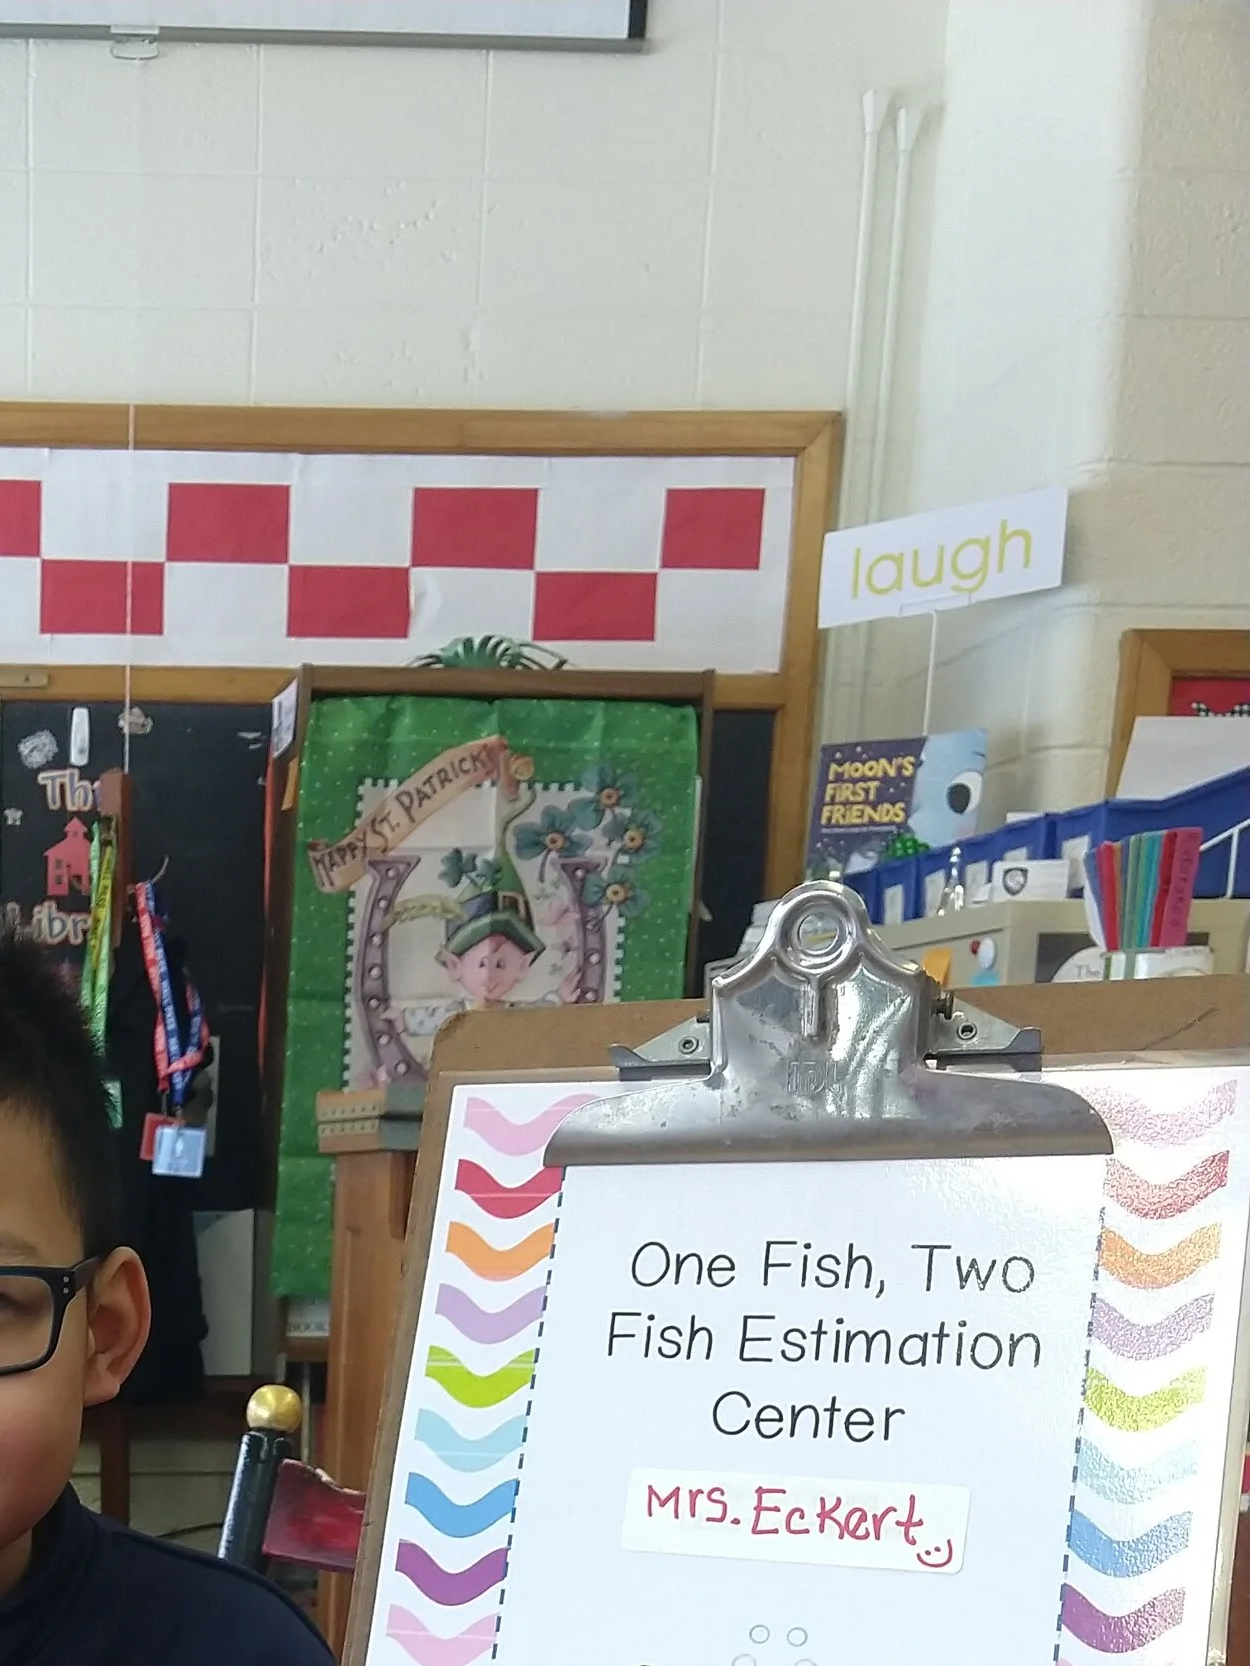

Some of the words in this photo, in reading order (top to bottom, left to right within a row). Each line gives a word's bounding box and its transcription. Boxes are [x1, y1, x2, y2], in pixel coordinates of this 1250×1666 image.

[851, 518, 1033, 599] laugh
[38, 768, 100, 811] Th
[828, 756, 916, 781] MOON'S
[313, 829, 368, 886] HAPPY
[631, 1241, 736, 1287] One
[762, 1241, 885, 1299] Fish,
[911, 1244, 1035, 1293] Two
[608, 1312, 713, 1360] Fish
[739, 1314, 1041, 1370] Estimation
[713, 1391, 905, 1442] Center
[647, 1484, 741, 1525] Mrs.
